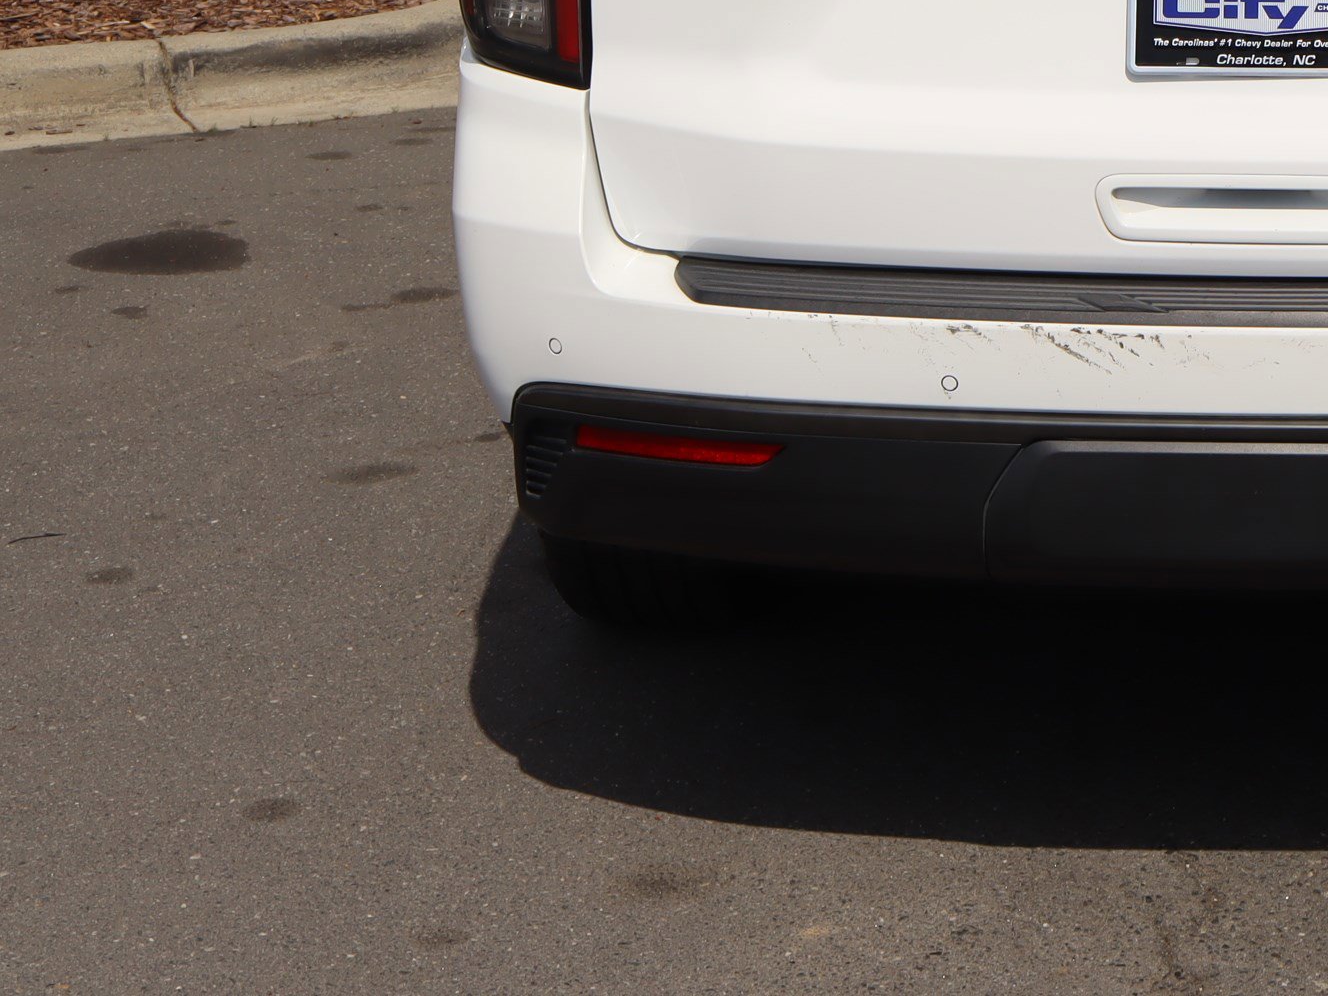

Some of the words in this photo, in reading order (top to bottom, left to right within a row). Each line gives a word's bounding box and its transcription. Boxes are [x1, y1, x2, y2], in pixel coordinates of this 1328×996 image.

[1153, 37, 1170, 47] The
[1171, 37, 1218, 47] Carolinas'
[1234, 38, 1261, 50] Chevy
[1263, 39, 1293, 48] Dealer
[1296, 39, 1311, 48] For
[1216, 53, 1287, 67] Charlotte,
[1292, 54, 1316, 66] NC
